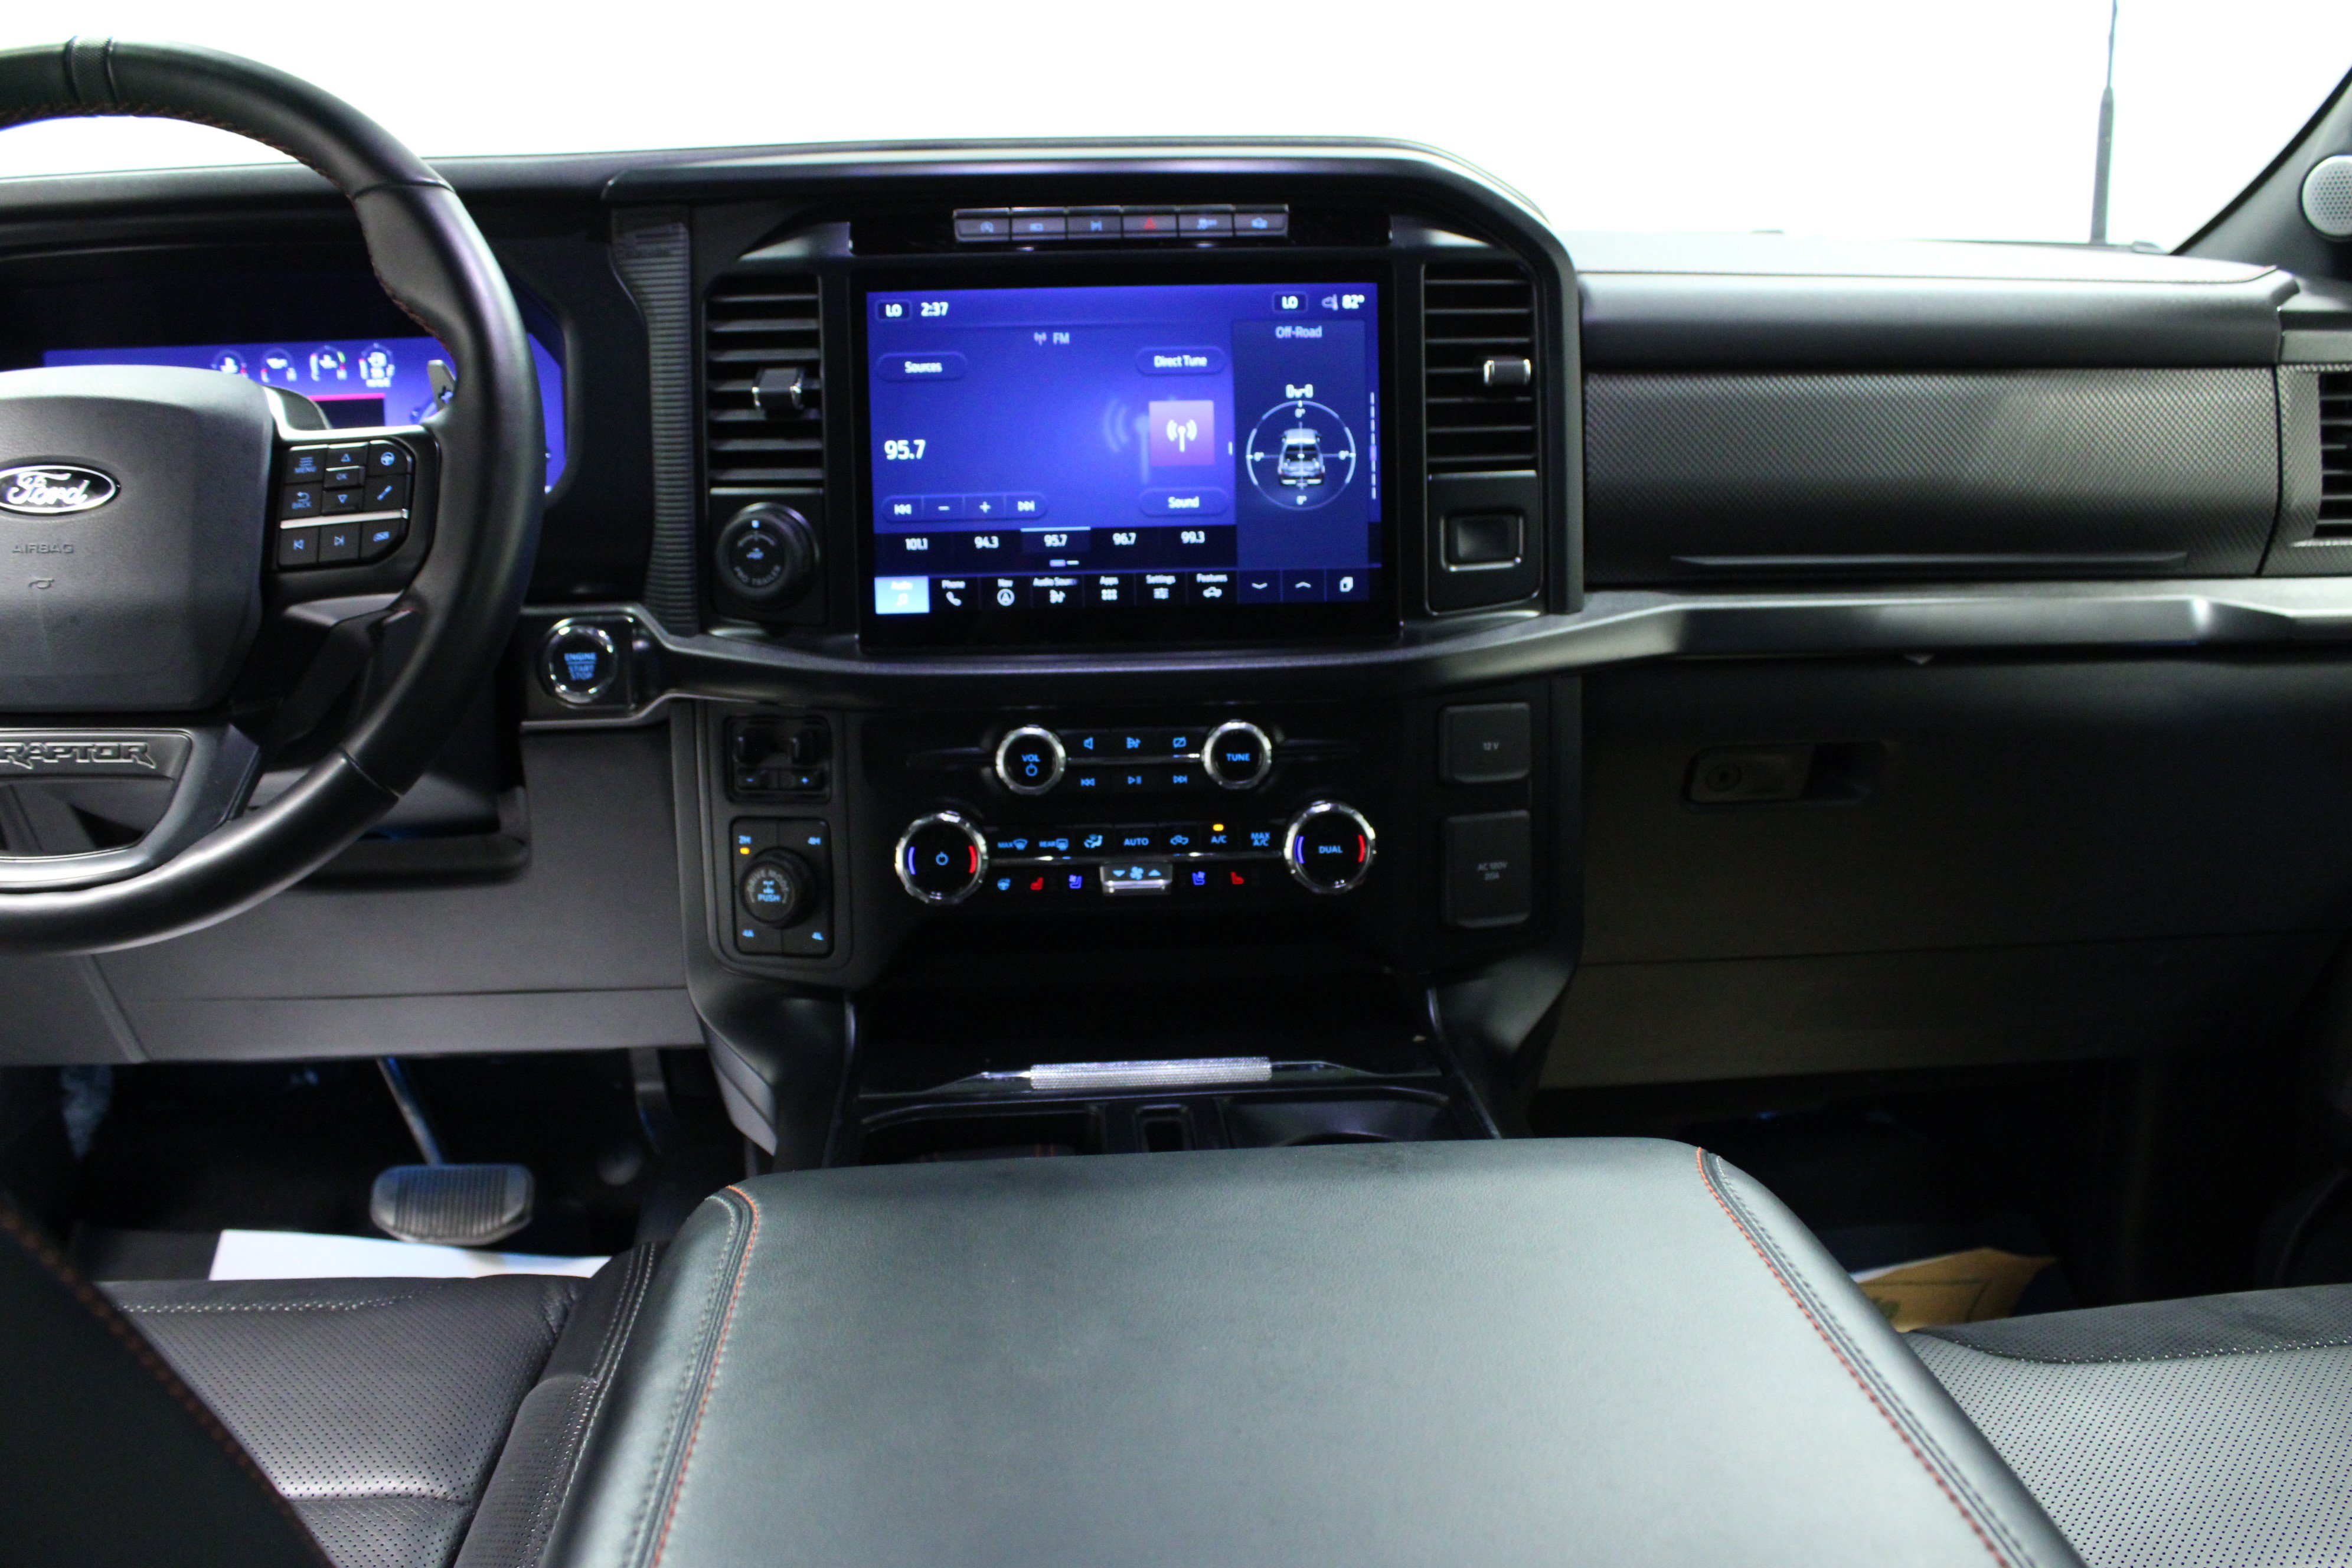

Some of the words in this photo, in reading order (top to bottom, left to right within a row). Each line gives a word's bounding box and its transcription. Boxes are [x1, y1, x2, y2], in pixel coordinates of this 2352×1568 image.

[1282, 296, 1298, 309] LO
[885, 303, 903, 317] LO
[920, 302, 949, 316] 2:37
[1275, 325, 1322, 339] Off-Road
[1053, 332, 1070, 345] FM
[904, 361, 943, 373] Sources
[1154, 355, 1182, 368] Direct
[1182, 354, 1208, 367] Tune
[884, 439, 926, 460] 95.7
[7, 472, 90, 505] Ford
[1168, 496, 1200, 509] Sound
[974, 536, 999, 549] 94.3
[1044, 534, 1068, 547] 95.7
[1112, 533, 1136, 545] 96.7
[1181, 531, 1206, 544] 99.3
[12, 544, 74, 554] AIRBAG
[1145, 574, 1176, 585] Settings
[0, 741, 157, 770] RAPTOR
[1021, 753, 1040, 763] VOL
[1226, 752, 1250, 762] TUNE
[1211, 835, 1228, 845] A/C
[1250, 831, 1270, 840] MAX
[1123, 837, 1149, 847] AUTO
[1252, 839, 1269, 847] A/C
[1318, 845, 1343, 854] DUAL
[757, 893, 782, 902] PUSH
